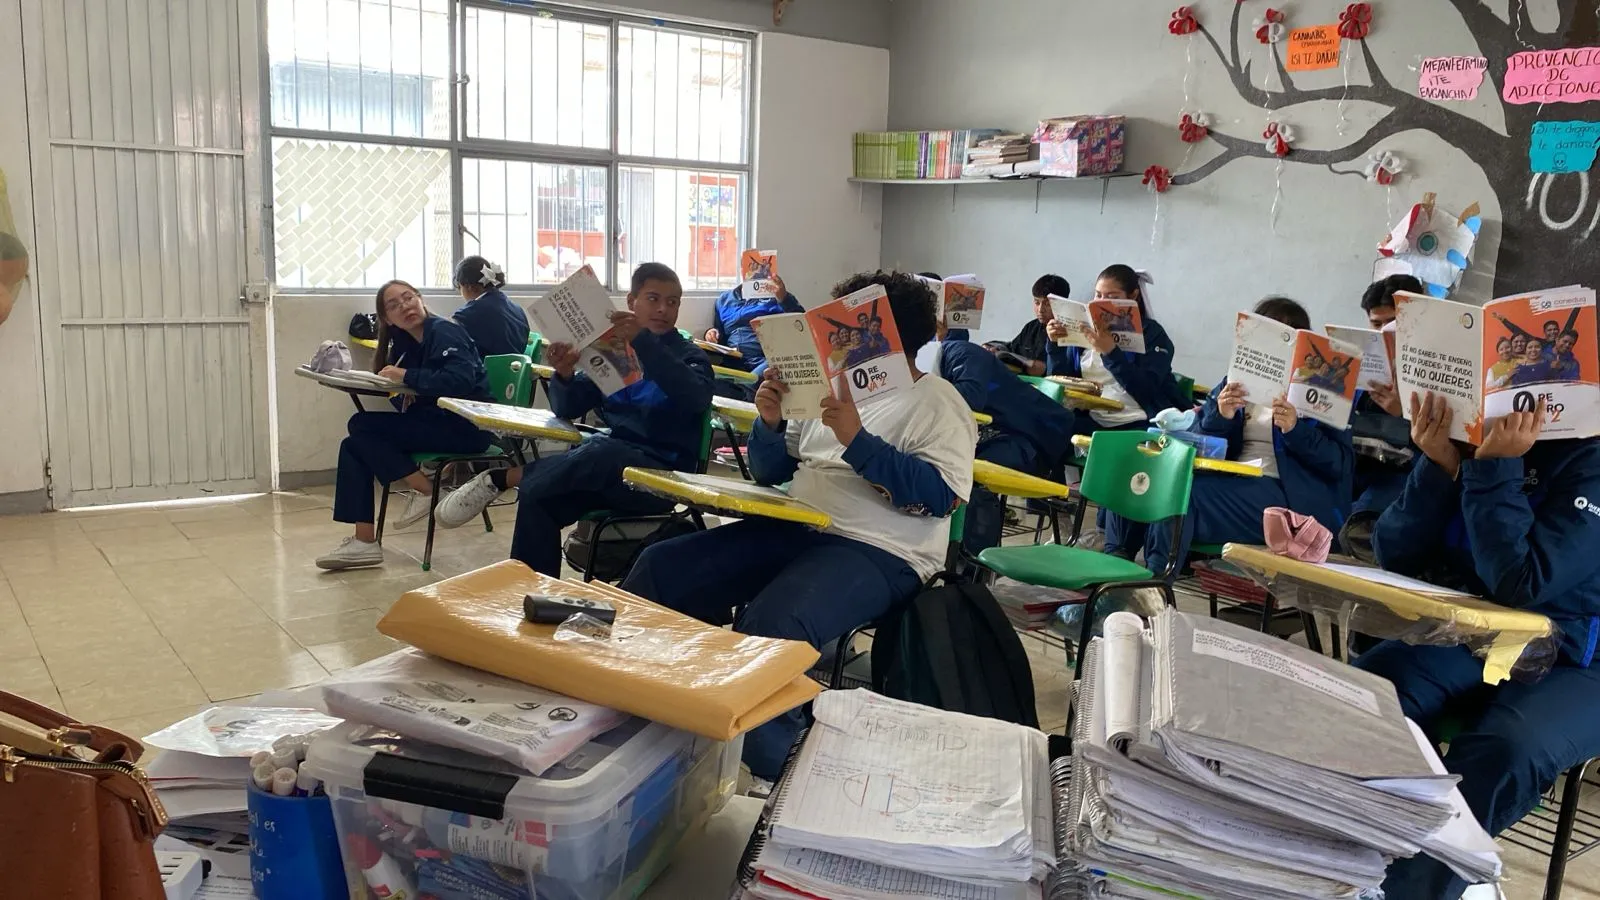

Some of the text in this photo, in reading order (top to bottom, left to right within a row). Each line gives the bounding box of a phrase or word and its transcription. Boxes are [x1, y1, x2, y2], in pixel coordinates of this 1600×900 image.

[1292, 30, 1326, 40] CANNABIS
[1546, 68, 1569, 82] DE
[868, 366, 878, 374] RE
[1402, 364, 1411, 374] SI
[1414, 367, 1426, 378] NO
[871, 372, 887, 382] PRO
